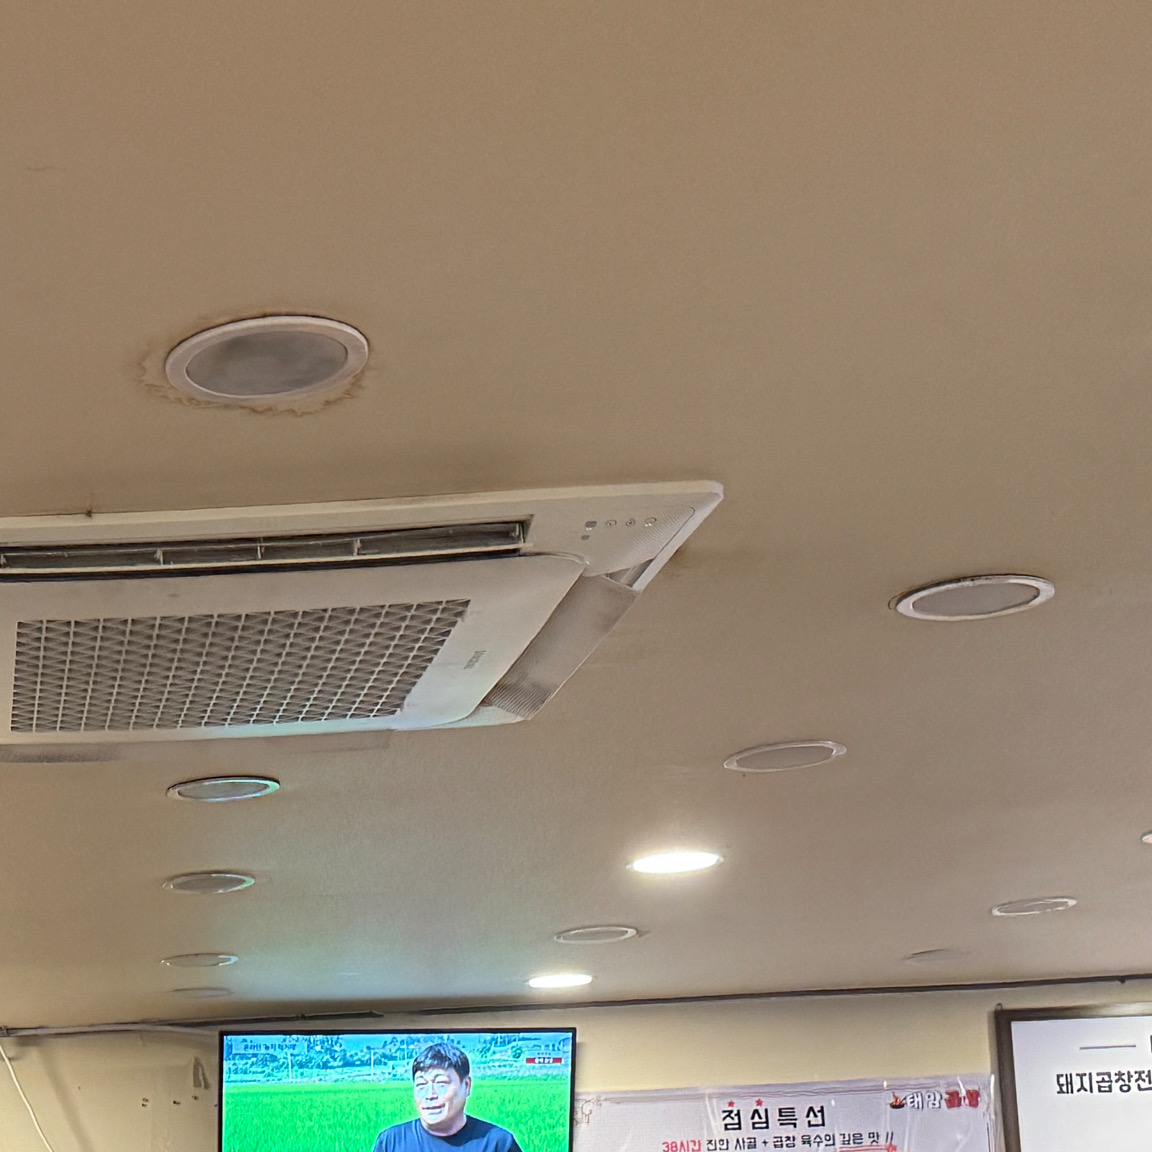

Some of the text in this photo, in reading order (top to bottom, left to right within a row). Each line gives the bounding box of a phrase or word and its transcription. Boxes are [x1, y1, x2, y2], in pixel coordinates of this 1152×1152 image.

[1056, 1069, 1152, 1094] 돼지곱창전
[722, 1105, 826, 1131] 점심특선
[706, 1139, 730, 1152] 진한
[735, 1137, 757, 1150] 사골
[773, 1136, 796, 1149] 곱창
[801, 1133, 835, 1148] 육수의
[839, 1132, 864, 1146] 깊은
[868, 1132, 880, 1145] 맛
